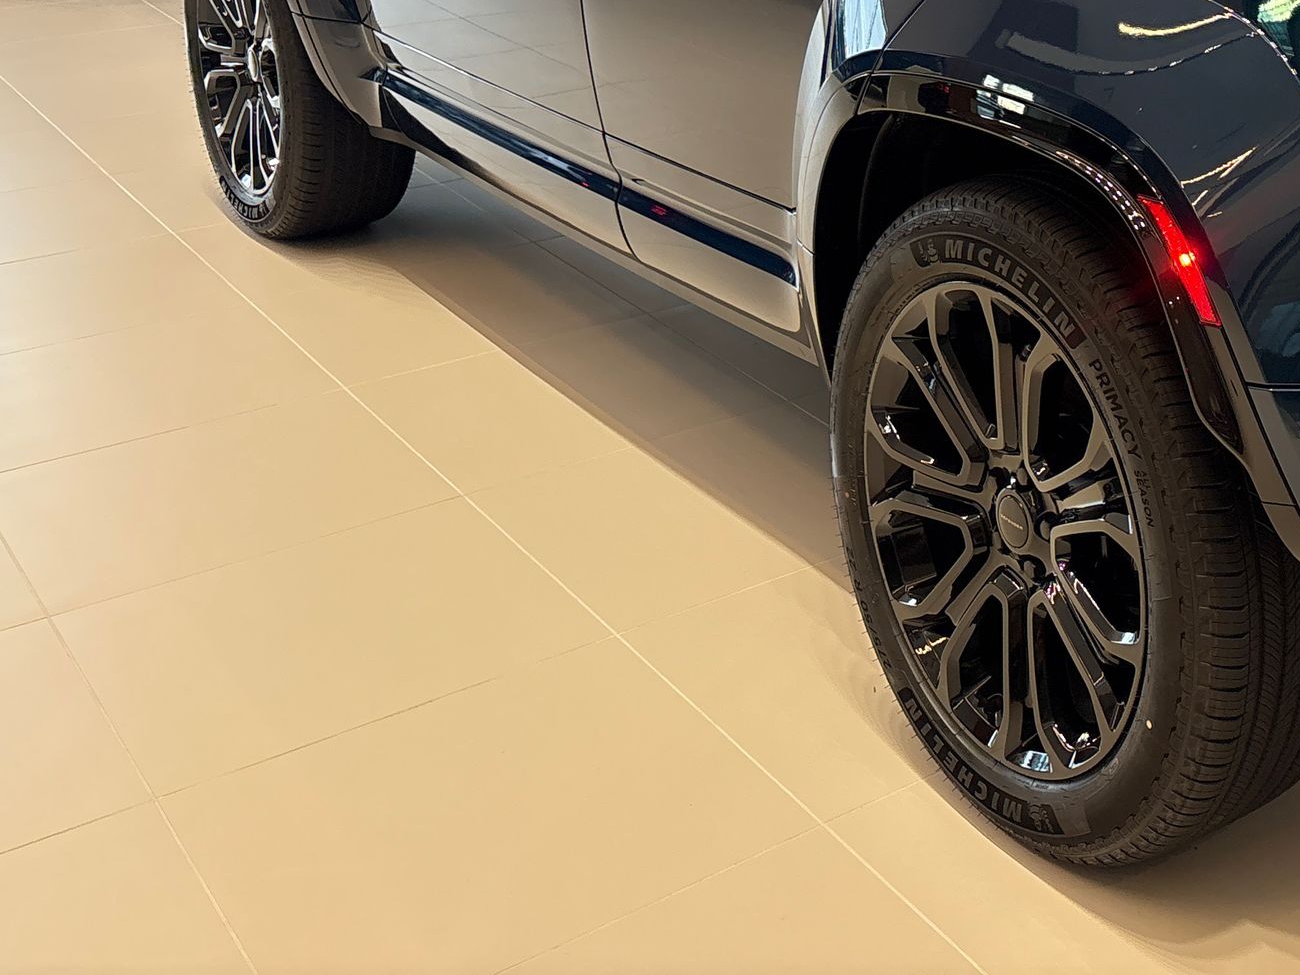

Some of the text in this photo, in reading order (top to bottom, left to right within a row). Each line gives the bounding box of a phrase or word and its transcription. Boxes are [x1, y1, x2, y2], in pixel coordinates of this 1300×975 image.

[944, 238, 1076, 339] MICHELIN
[1088, 357, 1143, 462] PRIMACY
[1133, 469, 1155, 528] SEASON
[845, 545, 858, 573] 22
[860, 599, 893, 670] 275/50
[904, 694, 1023, 824] MICHELIN
